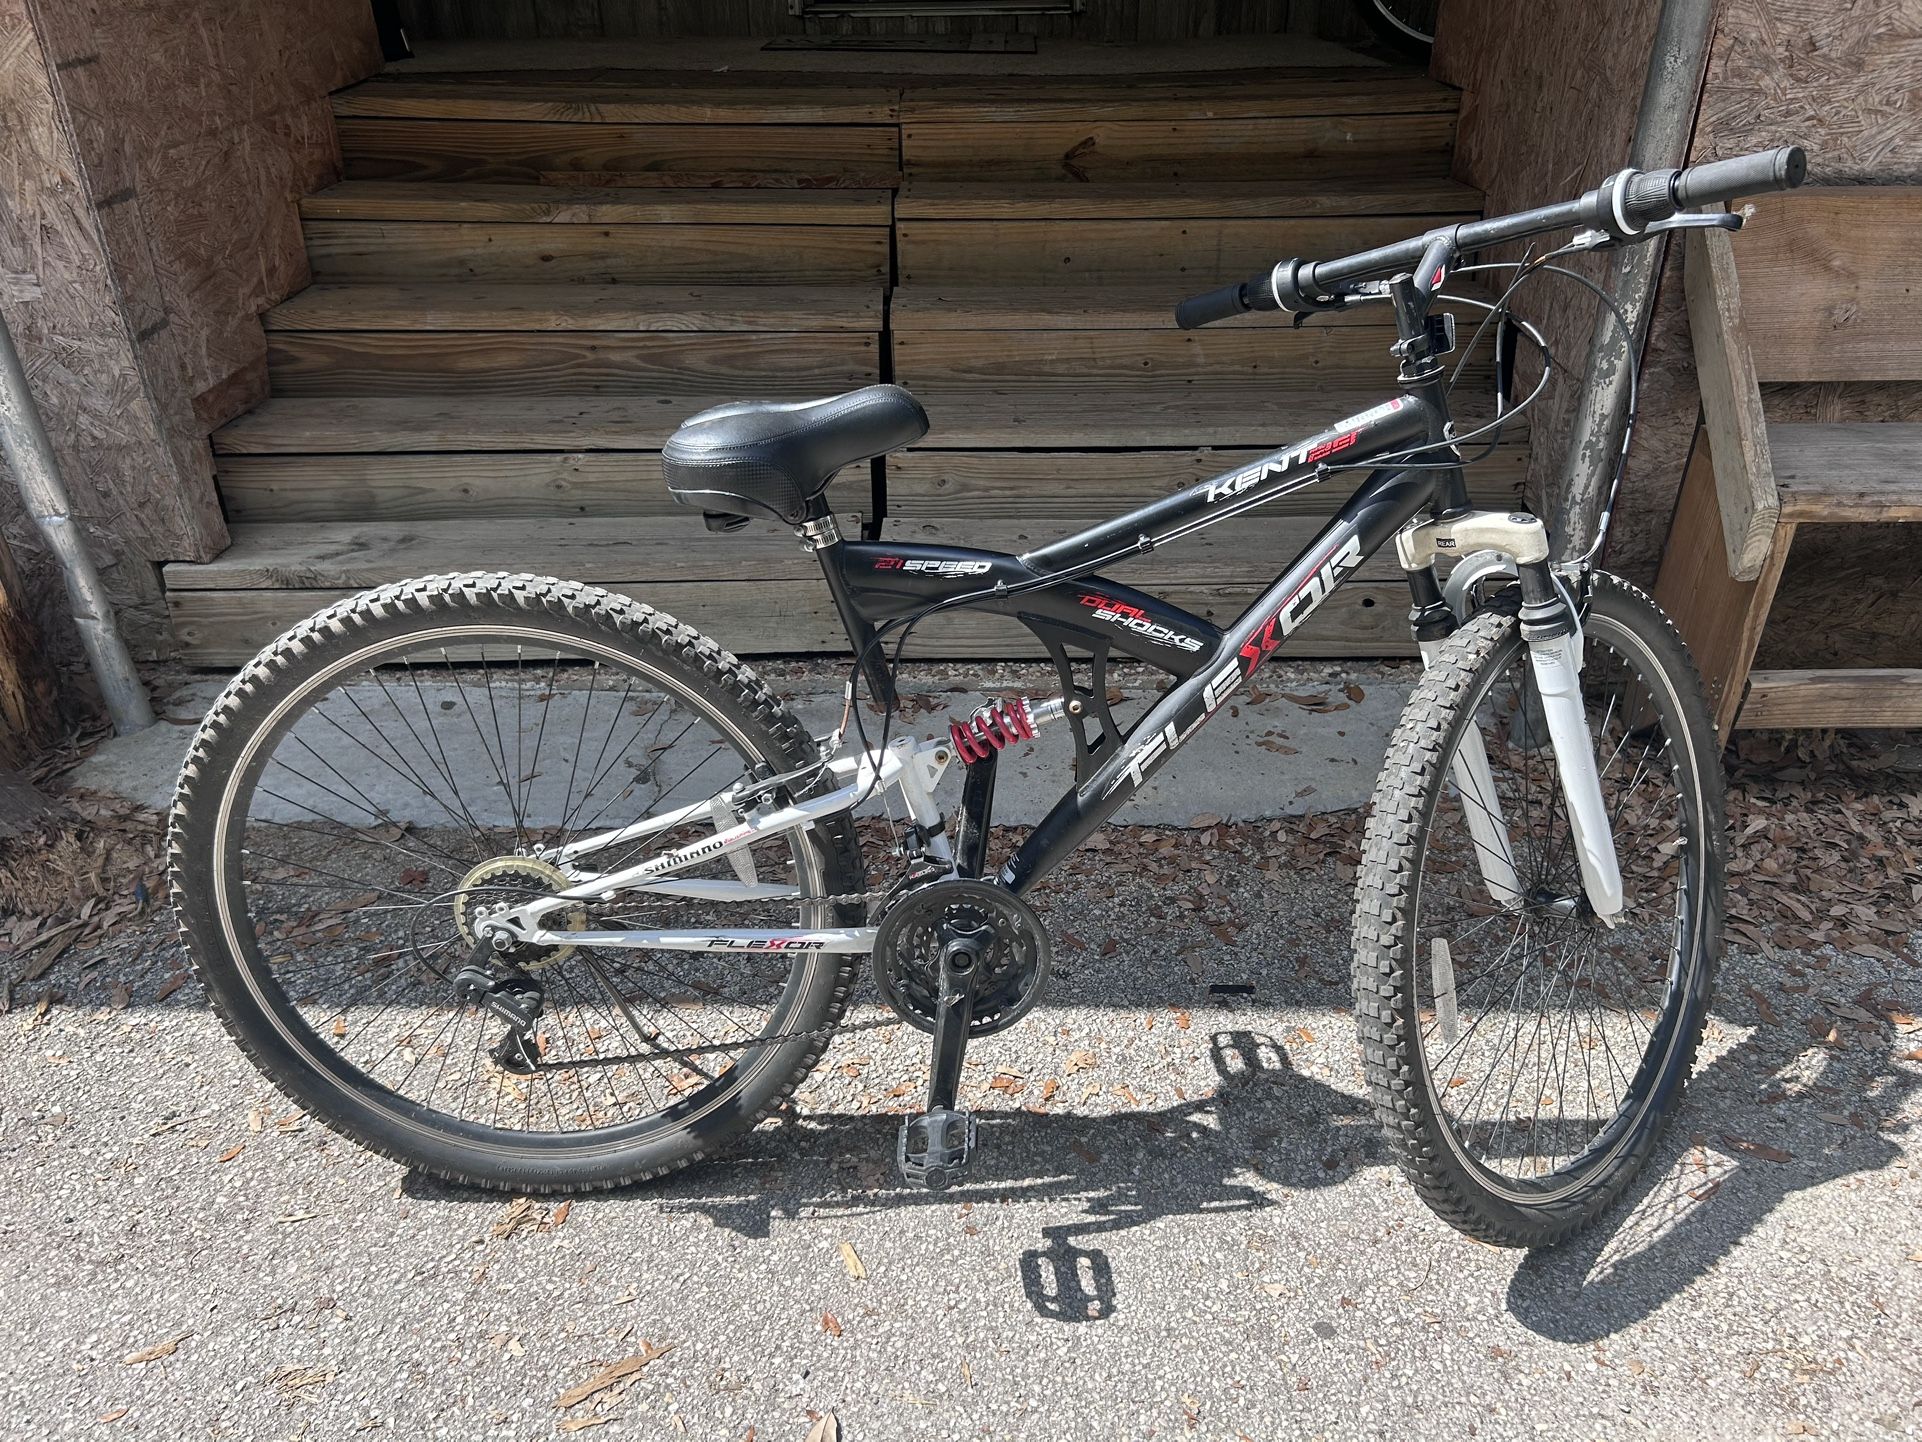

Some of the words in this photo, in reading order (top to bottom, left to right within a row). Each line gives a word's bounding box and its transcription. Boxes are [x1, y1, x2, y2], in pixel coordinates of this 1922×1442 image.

[1206, 442, 1318, 503] KENT
[874, 557, 904, 569] 21
[903, 560, 992, 573] SPEED
[1080, 594, 1153, 622] DUAL
[1092, 609, 1204, 653] SHOCKS
[1104, 534, 1364, 793] FLEXOR
[707, 939, 825, 950] FLEXOR
[491, 1001, 527, 1027] SHIMANO
